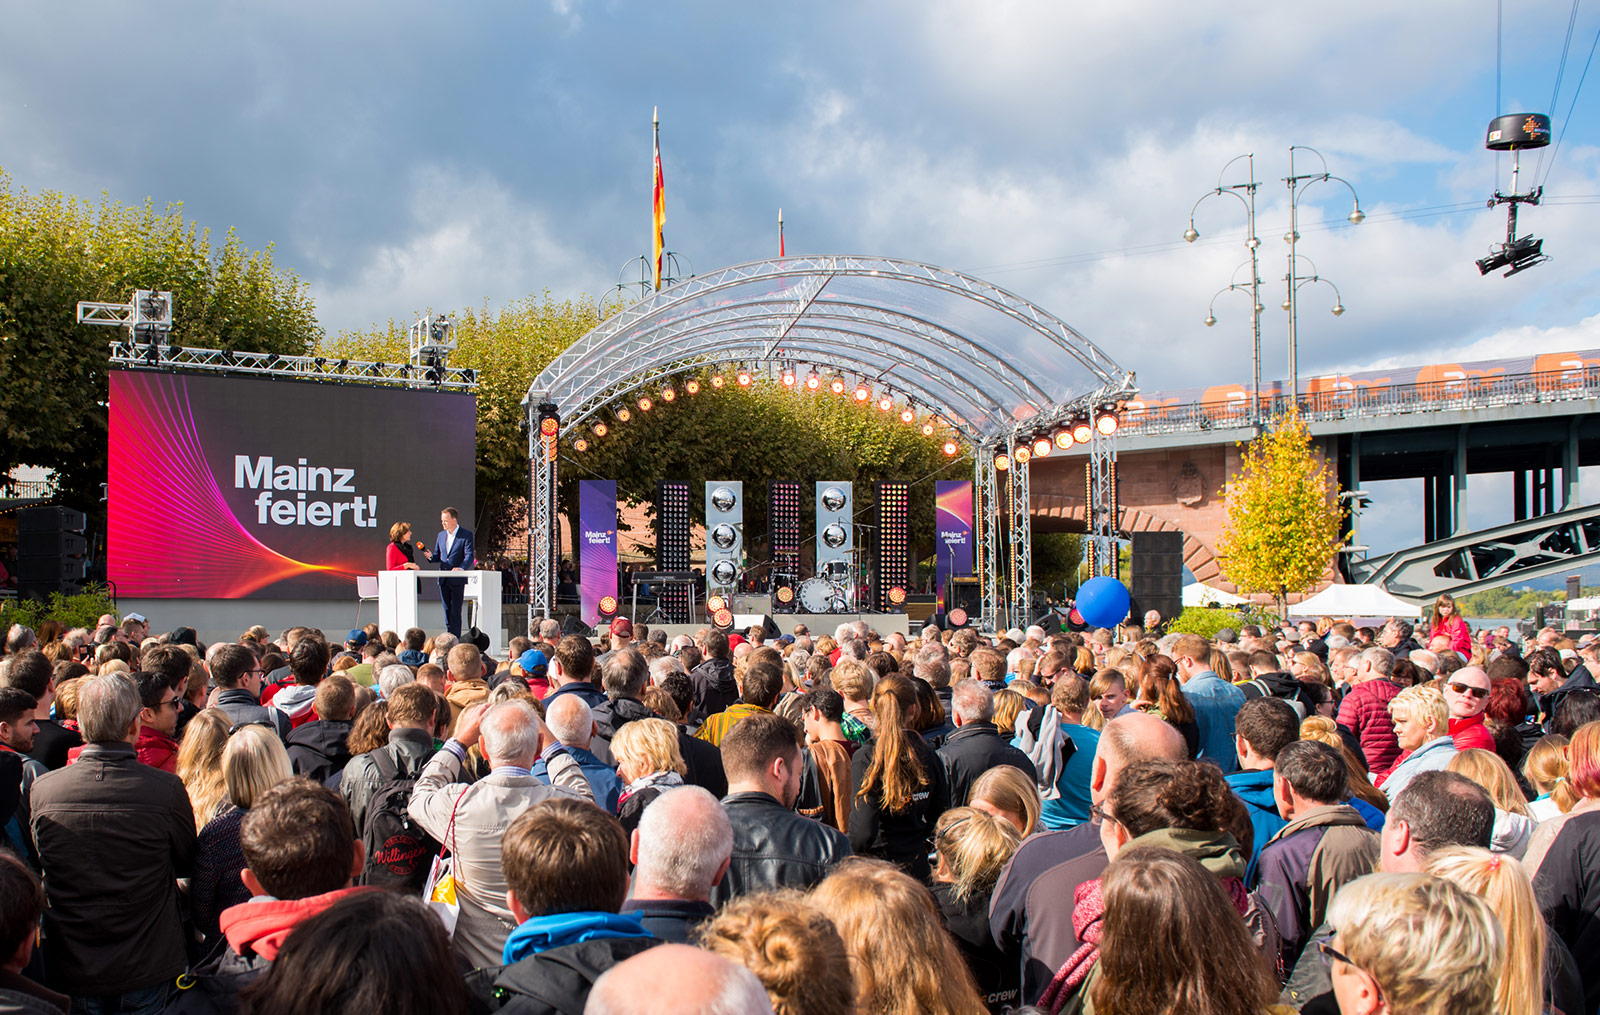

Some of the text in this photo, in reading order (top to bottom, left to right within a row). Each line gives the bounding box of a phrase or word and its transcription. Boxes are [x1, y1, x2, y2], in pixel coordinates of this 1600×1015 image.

[234, 454, 356, 493] Mainz
[254, 491, 378, 528] feiert!
[912, 791, 930, 801] crew
[375, 847, 427, 865] Willingen
[988, 989, 1018, 1003] crew
